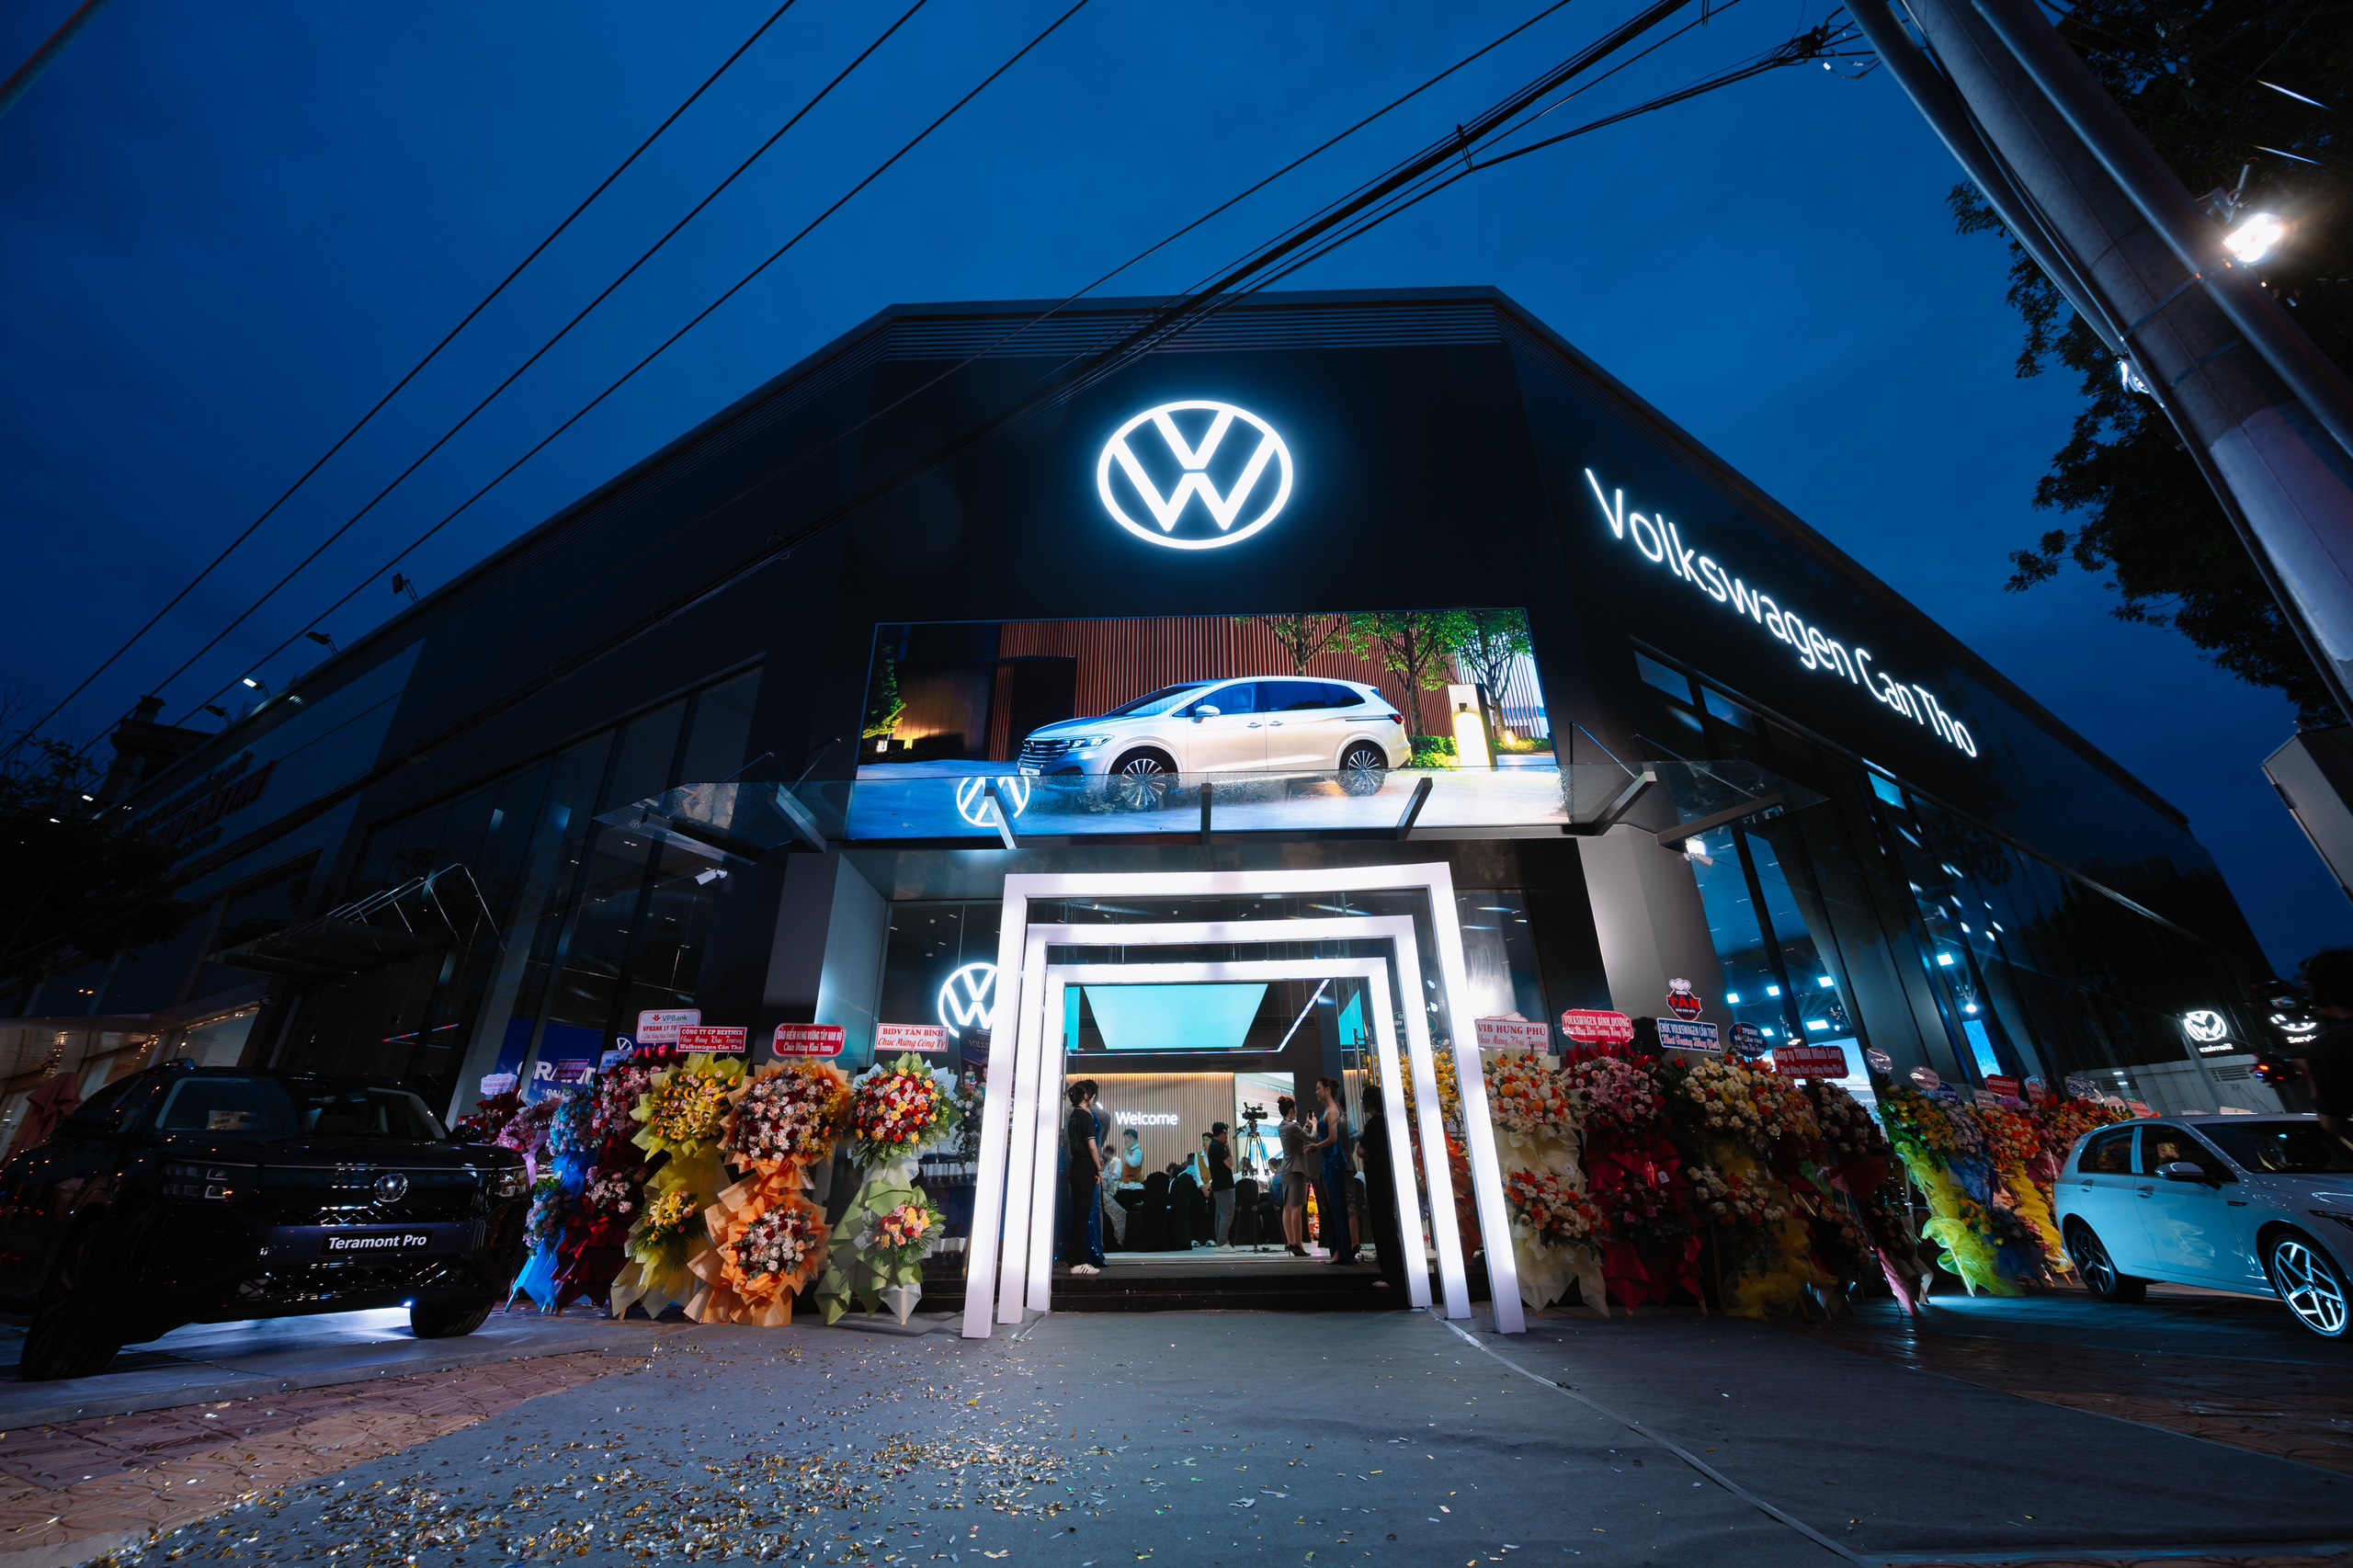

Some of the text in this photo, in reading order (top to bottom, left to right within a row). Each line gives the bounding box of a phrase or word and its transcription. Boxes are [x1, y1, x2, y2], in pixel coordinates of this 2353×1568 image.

[1585, 468, 1978, 758] Volkswagen Can Tho
[662, 1014, 688, 1022] VPBank
[882, 1028, 904, 1036] BIDV
[1477, 1024, 1494, 1032] VIB
[1527, 1026, 1546, 1036] PHÚ
[1115, 1111, 1178, 1126] Welcome
[328, 1234, 427, 1250] Teramont Pro
